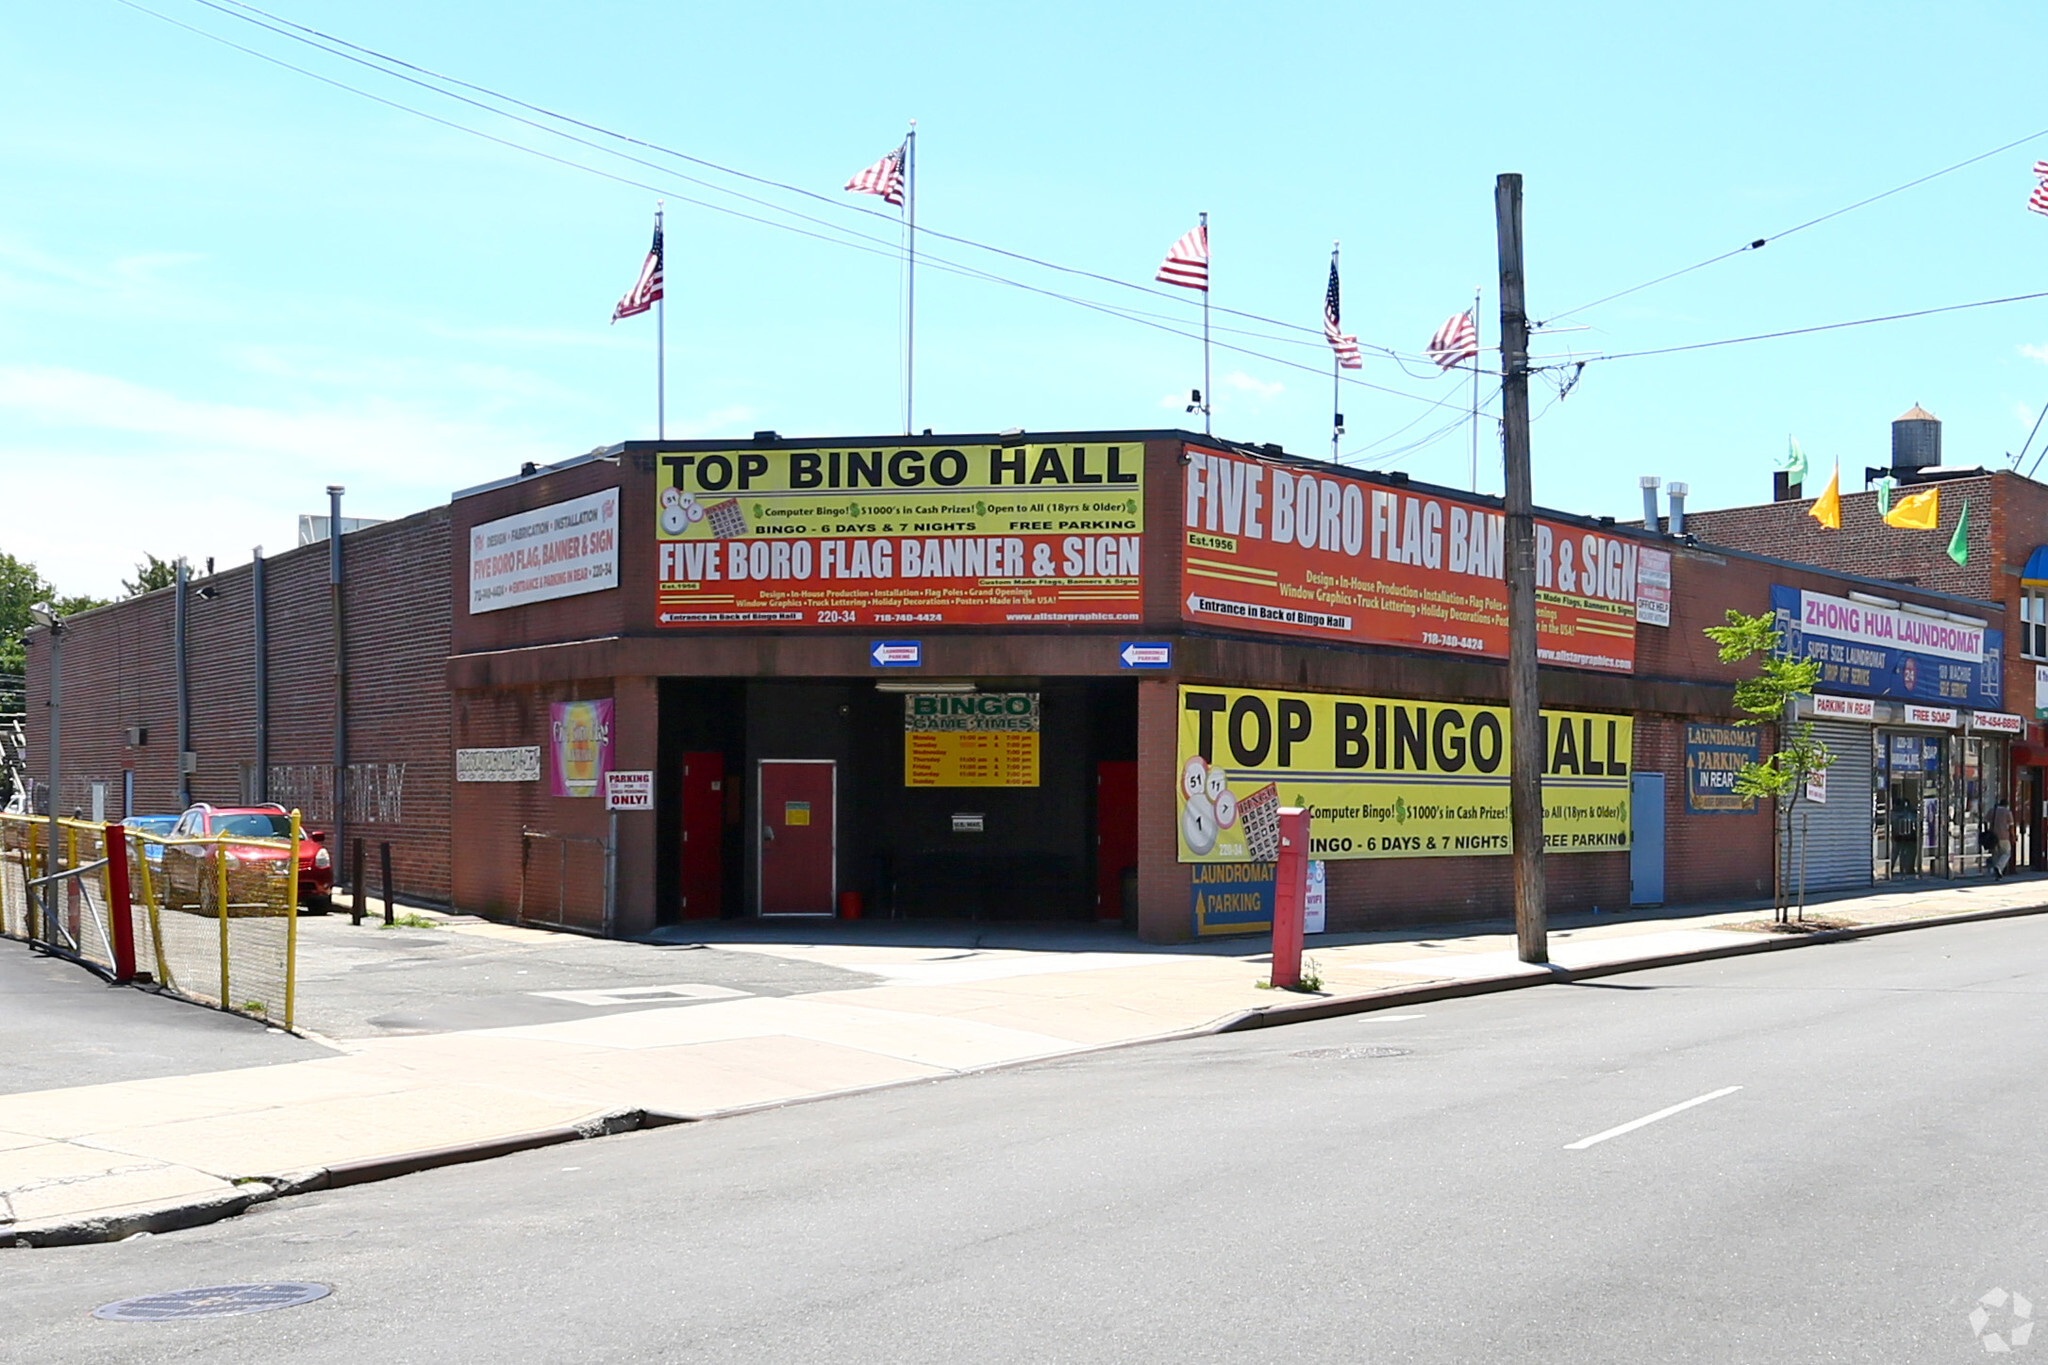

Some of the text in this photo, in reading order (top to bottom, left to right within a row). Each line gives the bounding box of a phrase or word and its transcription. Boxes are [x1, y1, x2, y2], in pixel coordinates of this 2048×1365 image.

[662, 447, 1137, 490] TOP BINGO HALL
[764, 508, 814, 518] Computer
[816, 506, 848, 518] Bingo!
[903, 504, 913, 514] in
[916, 504, 938, 514] Cash
[942, 504, 974, 514] Prizes!
[988, 504, 1014, 515] Open
[1016, 505, 1026, 513] to
[1030, 504, 1044, 513] All
[1047, 503, 1079, 514] (18yrs
[1083, 504, 1090, 512] &
[1093, 502, 1126, 513] Older)
[554, 509, 598, 531] INSTALLATION
[756, 526, 806, 534] BINGO
[822, 524, 830, 533] 6
[836, 524, 876, 533] DAYS
[883, 524, 894, 532] &
[914, 523, 976, 531] NIGHTS
[1009, 522, 1052, 530] FREE
[1059, 520, 1136, 529] PARKING
[1187, 451, 1638, 602] FIVE BORO FLAG BANR & SIGN
[1189, 534, 1233, 550] Est.1956
[474, 558, 491, 580] FIVE
[493, 552, 515, 576] BORO
[542, 536, 580, 565] BANNER
[590, 528, 613, 554] SIGN
[660, 536, 1140, 581] FIVE BORO FLAG BANNER & SIGN
[925, 589, 941, 597] Flag
[943, 588, 963, 596] Poles
[969, 588, 993, 596] Grand
[995, 588, 1032, 598] Openings
[1306, 570, 1502, 611] Design In-House Production Installation Flag Poles
[769, 600, 802, 608] Graphics
[831, 598, 866, 608] Lettering
[872, 598, 901, 607] Holiday
[903, 597, 950, 605] Decorations
[1280, 583, 1490, 624] Window Graphics Truck Lettering Holiday Decorations
[1543, 594, 1560, 602] Made
[1584, 601, 1609, 611] Banners
[818, 610, 855, 622] 220-34
[1006, 612, 1139, 621] www.allstargraphics.com
[1200, 600, 1345, 628] Entrance in Back of Bingo Hall
[1549, 622, 1559, 634] the
[1806, 601, 1980, 654] ZHONG HUA LAUNDROMAT
[1422, 632, 1484, 649] 718-740-4424
[1904, 670, 1914, 681] 24
[914, 696, 1031, 715] BINGO
[1817, 699, 1871, 715] PARKING IN REAR
[914, 719, 1031, 728] GAME TIMES
[1913, 709, 1951, 723] FREE SOAP
[1185, 692, 1312, 768] TOP
[1335, 702, 1502, 773] BINGO
[1688, 728, 1757, 747] LAUNDROMAT
[1190, 774, 1201, 788] 51
[1700, 772, 1734, 787] IN REAR
[612, 795, 647, 805] ONLY!
[1309, 804, 1508, 823] Computer Bingo! in Cash Prizes!
[1552, 806, 1562, 818] All
[1564, 806, 1587, 821] (18yrs
[1590, 806, 1595, 818] &
[1596, 806, 1619, 819] Older)
[1196, 816, 1202, 831] 1
[1310, 836, 1508, 852] INGO 6 DAYS & 7 NIGHTS
[1543, 835, 1568, 846] REE
[1192, 864, 1275, 884] LAUNDROMAT
[1208, 892, 1261, 913] PARKING
